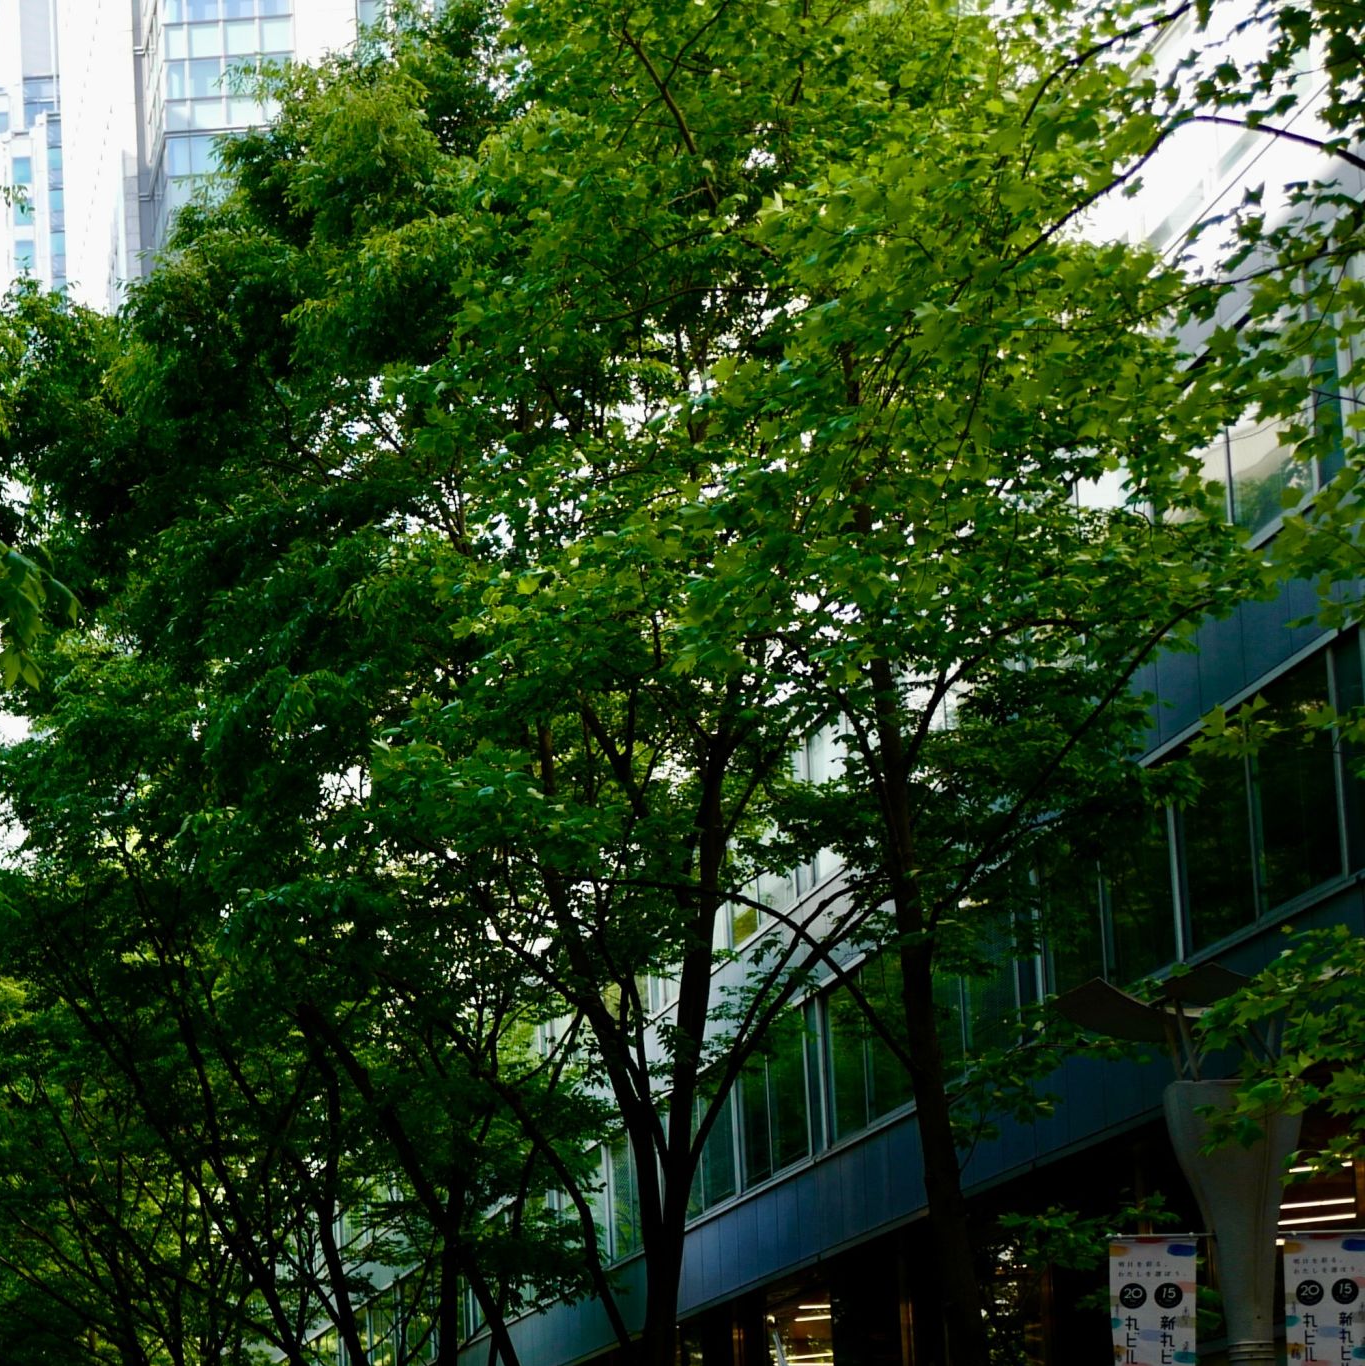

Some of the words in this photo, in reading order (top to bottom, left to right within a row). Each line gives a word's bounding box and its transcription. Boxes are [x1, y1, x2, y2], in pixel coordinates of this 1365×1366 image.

[1124, 1287, 1143, 1299] 20
[1162, 1287, 1176, 1299] 15
[1300, 1284, 1320, 1296] 20
[1339, 1283, 1353, 1295] 15
[1125, 1316, 1140, 1364] 丸ビル
[1303, 1312, 1318, 1361] 丸ビル
